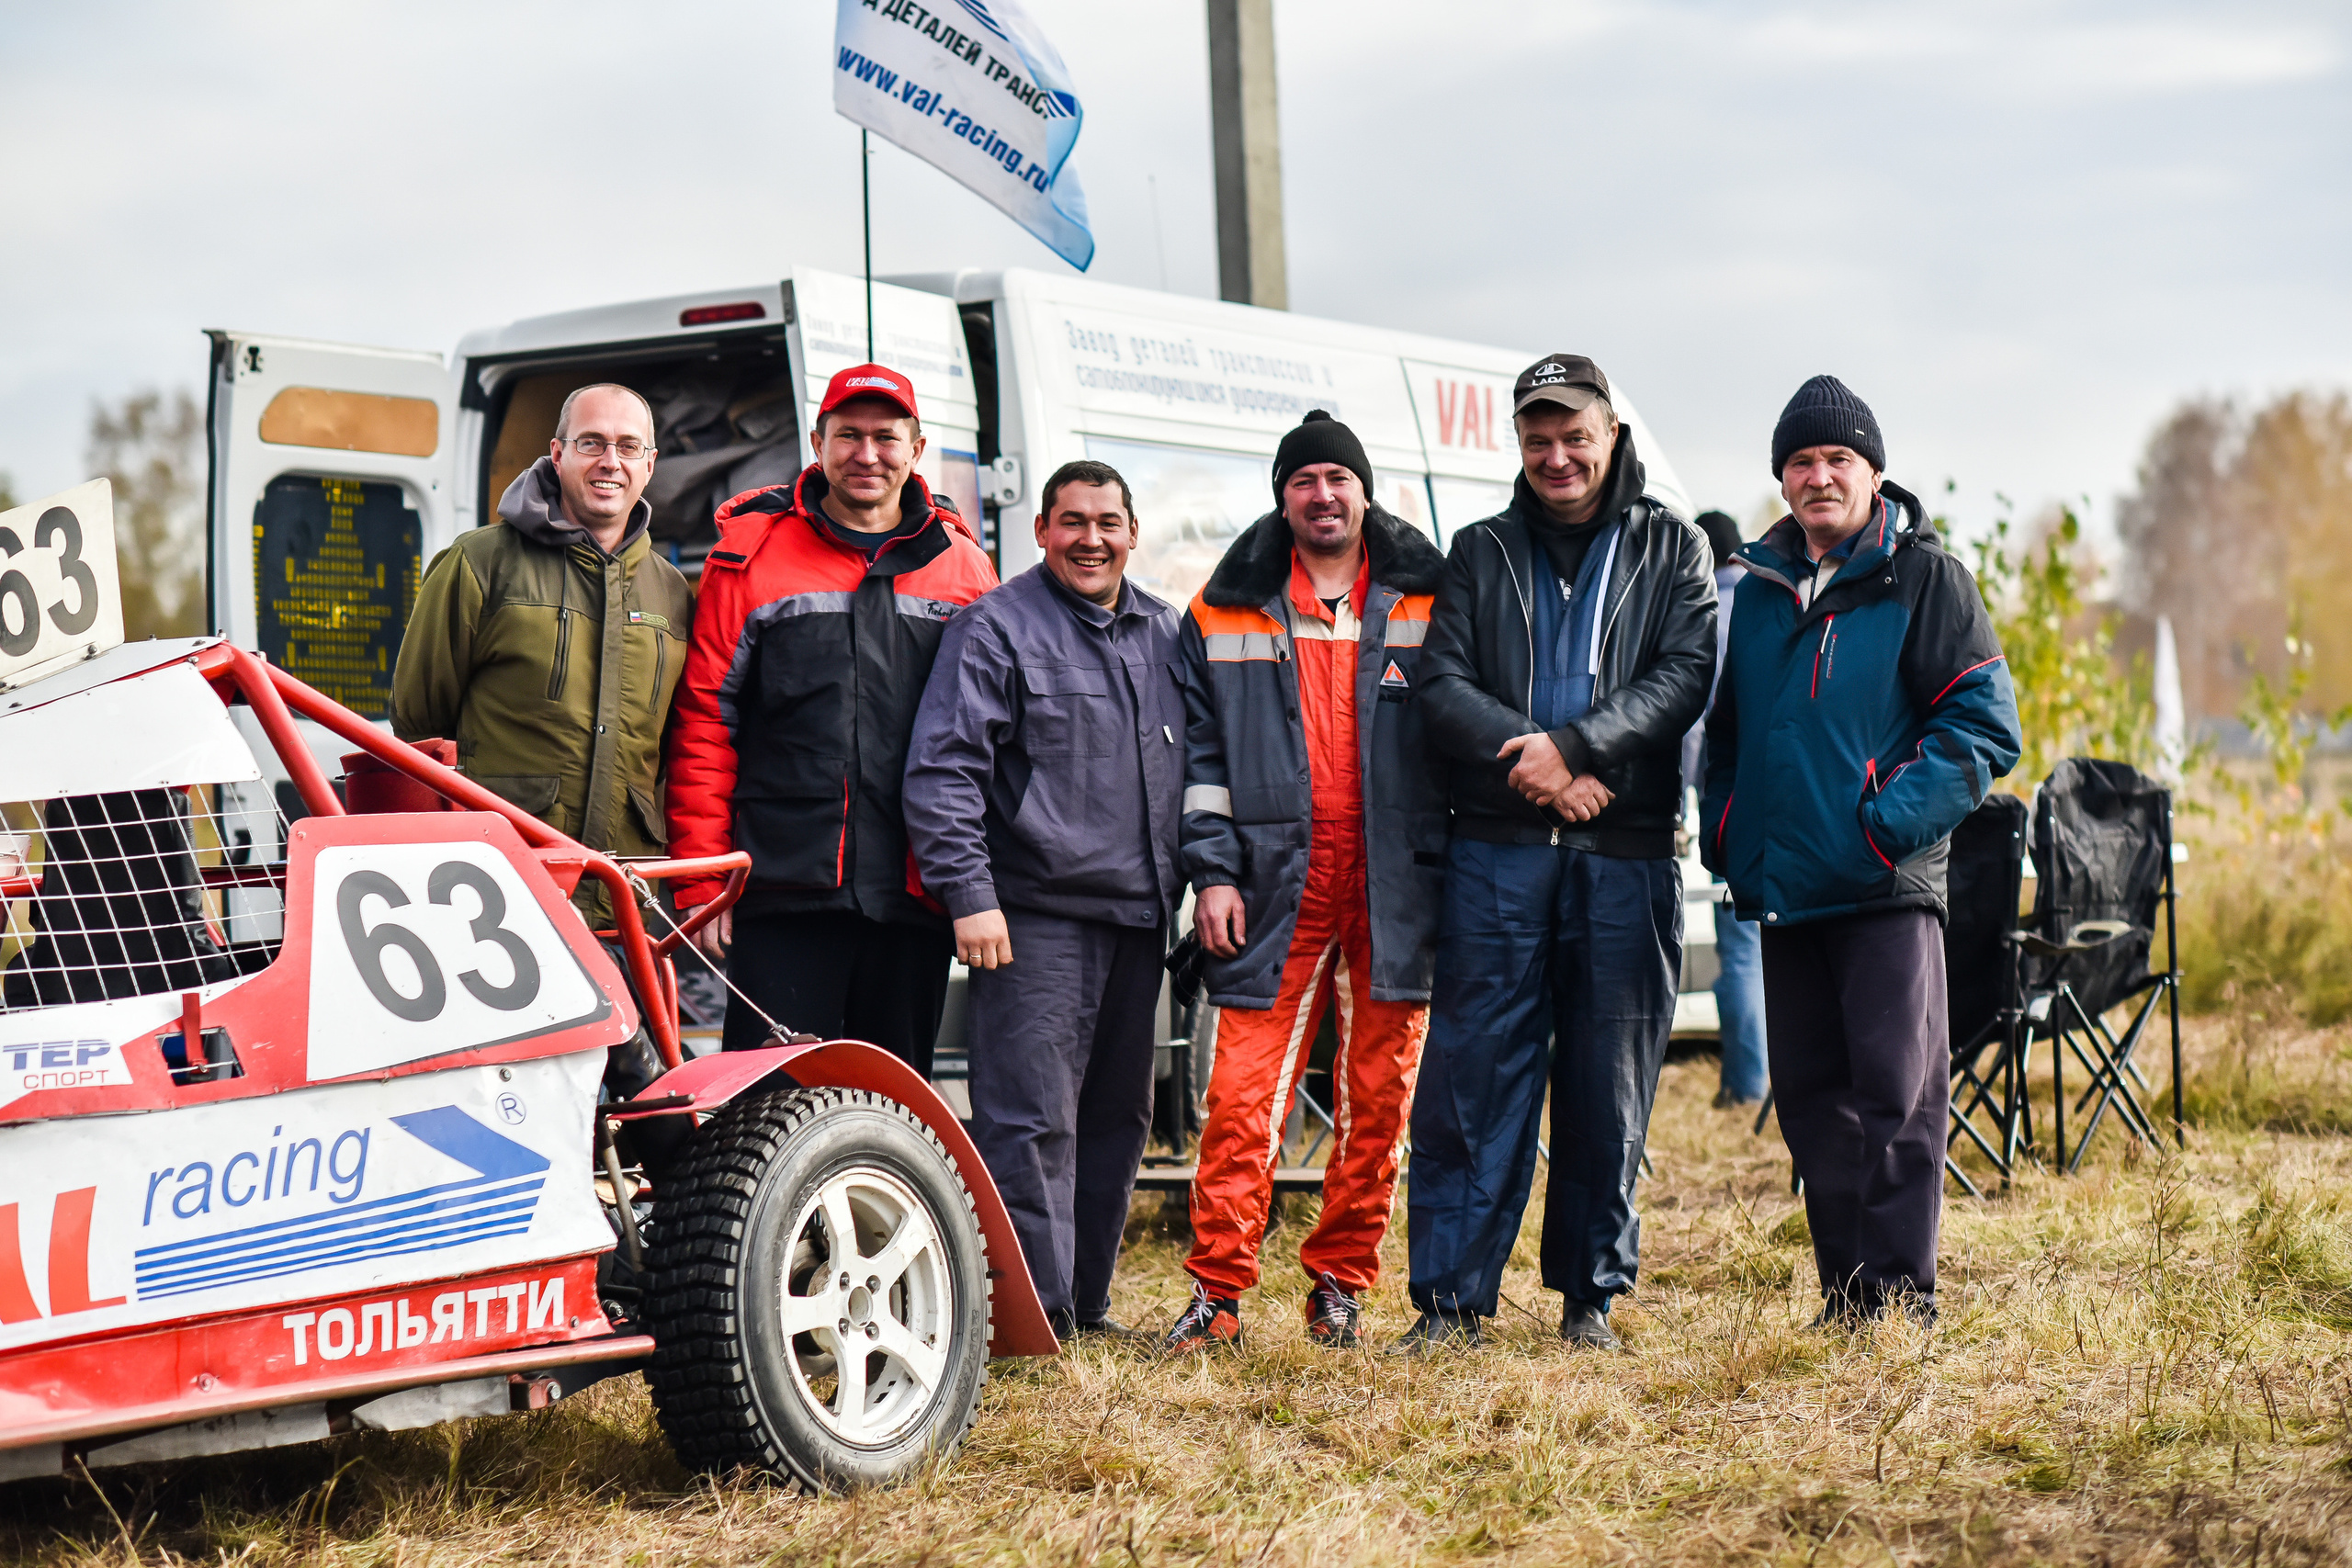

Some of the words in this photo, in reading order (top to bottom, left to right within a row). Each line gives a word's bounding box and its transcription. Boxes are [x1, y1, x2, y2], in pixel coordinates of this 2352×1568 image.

[881, 0, 982, 66] ДЕТАЛЕЙ
[984, 55, 1047, 119] ТРАНС
[837, 46, 1051, 194] www.val-racing.ru
[1435, 378, 1500, 452] VAL
[1532, 376, 1566, 386] LADA
[0, 506, 98, 657] 63
[336, 860, 541, 1022] 63
[23, 1069, 109, 1089] СПОРТ
[143, 1124, 371, 1227] racing
[282, 1277, 566, 1366] ТОЛЬЯТТИ
